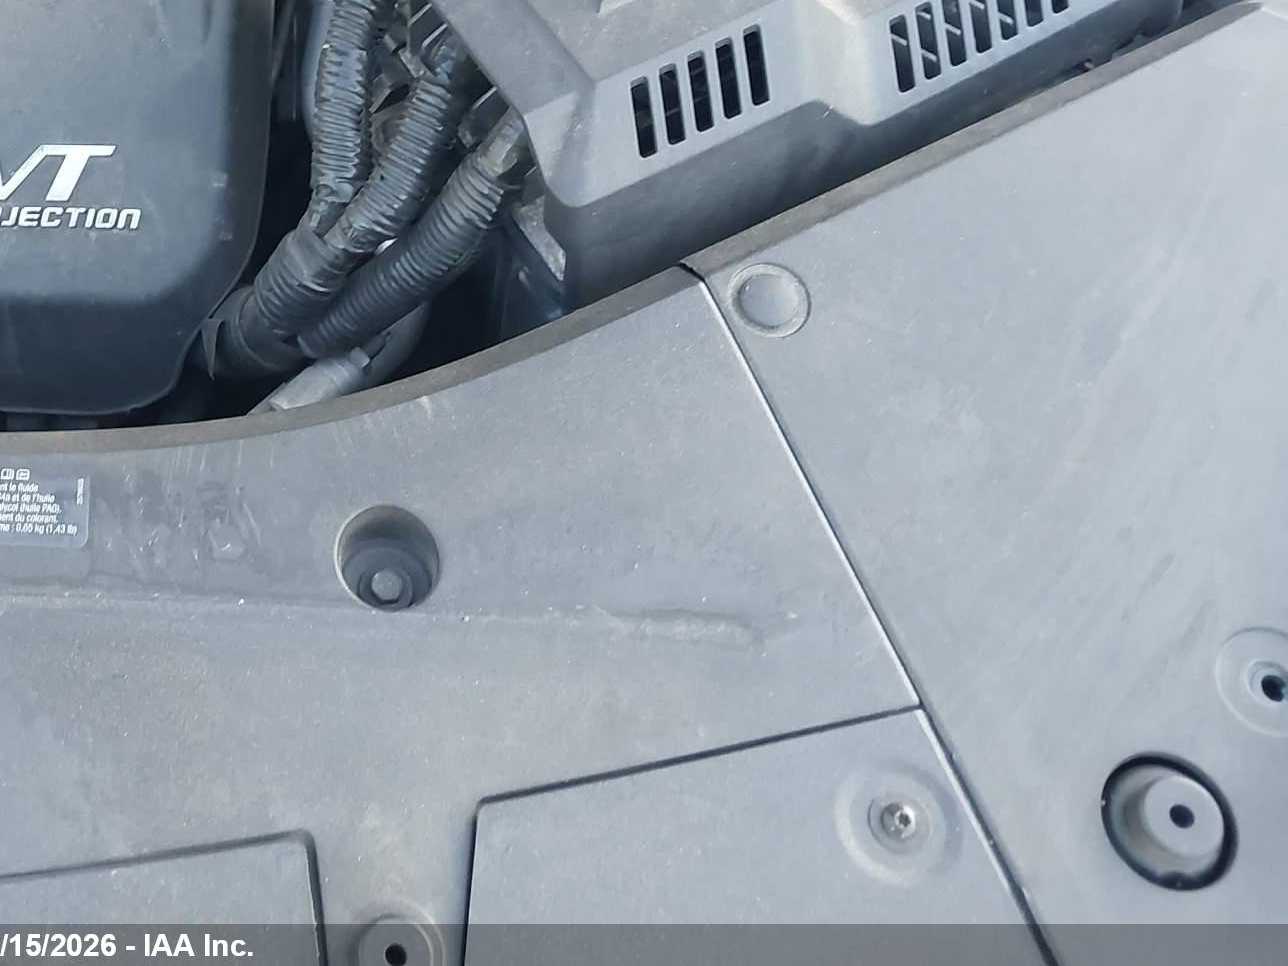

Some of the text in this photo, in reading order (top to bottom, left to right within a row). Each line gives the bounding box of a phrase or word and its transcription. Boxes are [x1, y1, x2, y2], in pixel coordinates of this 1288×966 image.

[9, 482, 17, 493] le
[17, 482, 39, 493] fluide
[11, 493, 20, 502] et
[20, 493, 32, 503] de
[14, 513, 26, 523] du
[34, 523, 46, 535] kg
